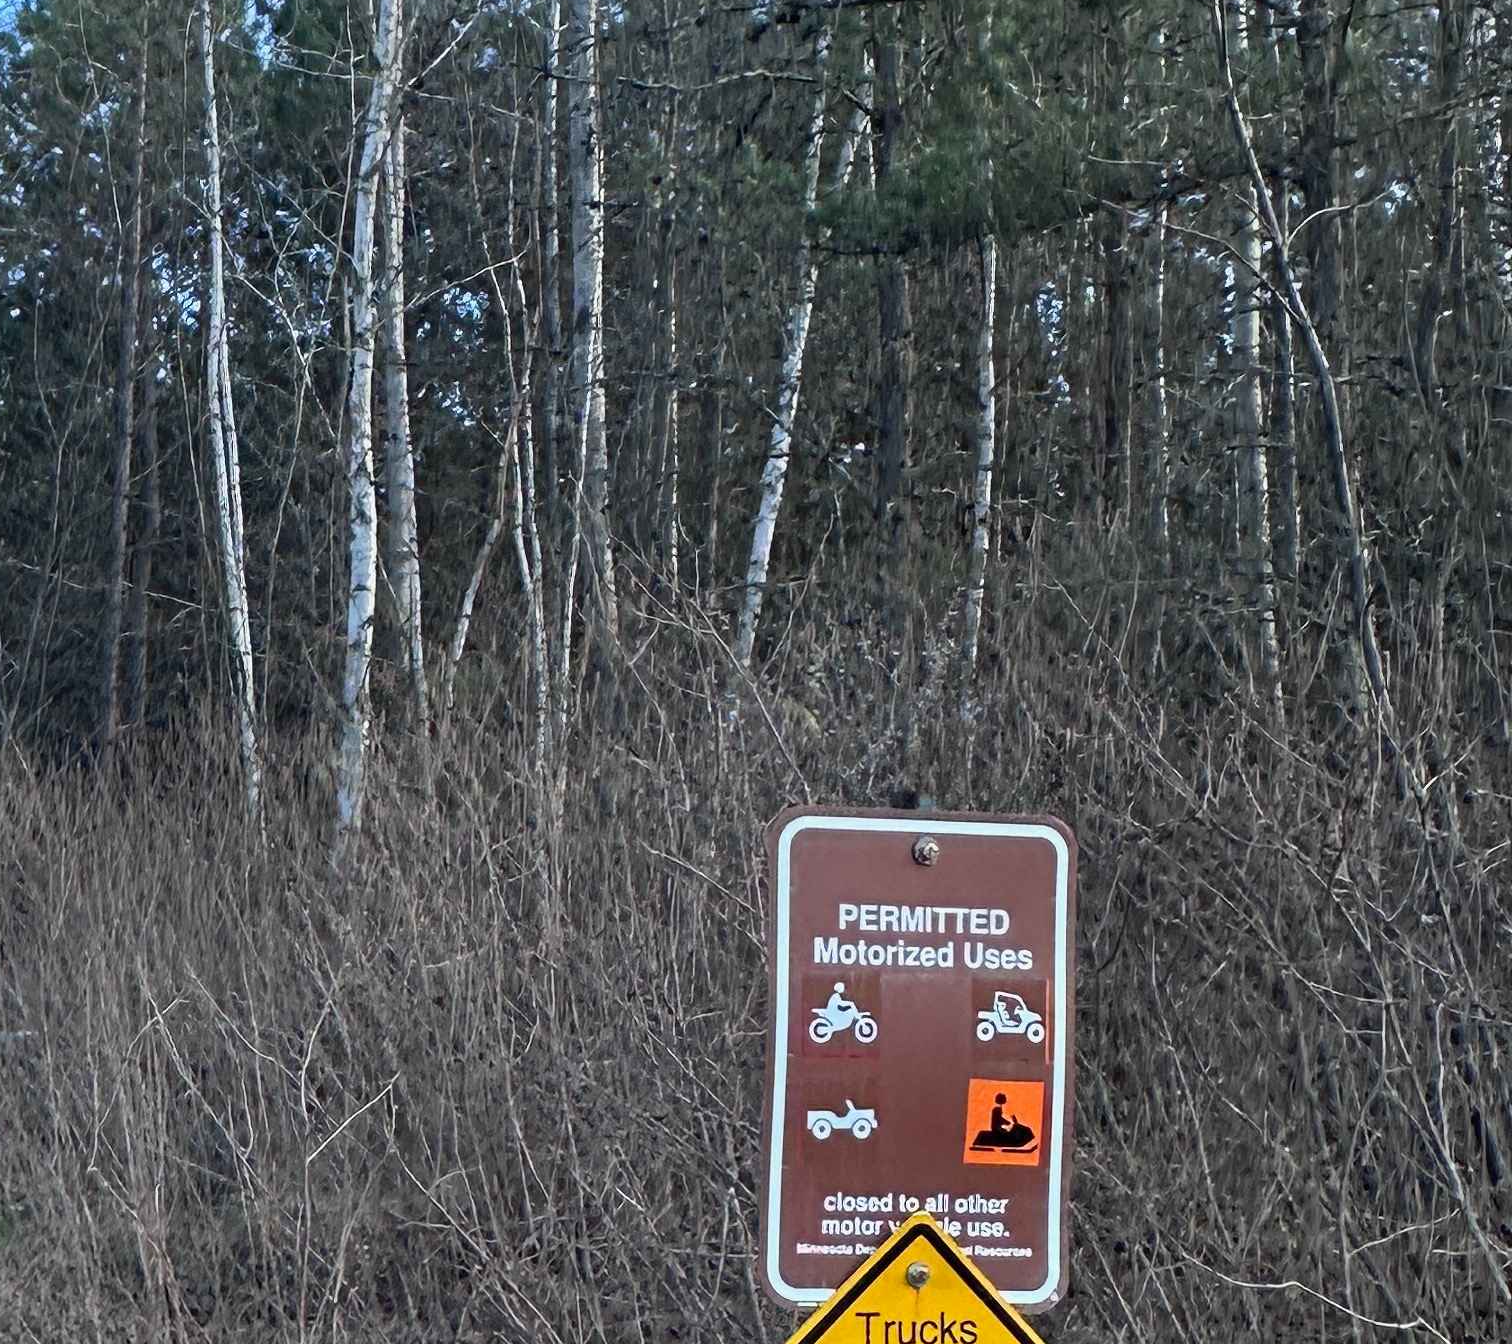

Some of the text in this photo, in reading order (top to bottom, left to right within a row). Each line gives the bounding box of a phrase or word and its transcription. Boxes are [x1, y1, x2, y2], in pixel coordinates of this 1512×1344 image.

[839, 903, 1010, 935] PERMITTED
[813, 937, 1033, 970] Motorized Uses
[823, 1192, 1009, 1215] closed to all other
[821, 1217, 884, 1236] motor
[967, 1221, 1010, 1238] use.
